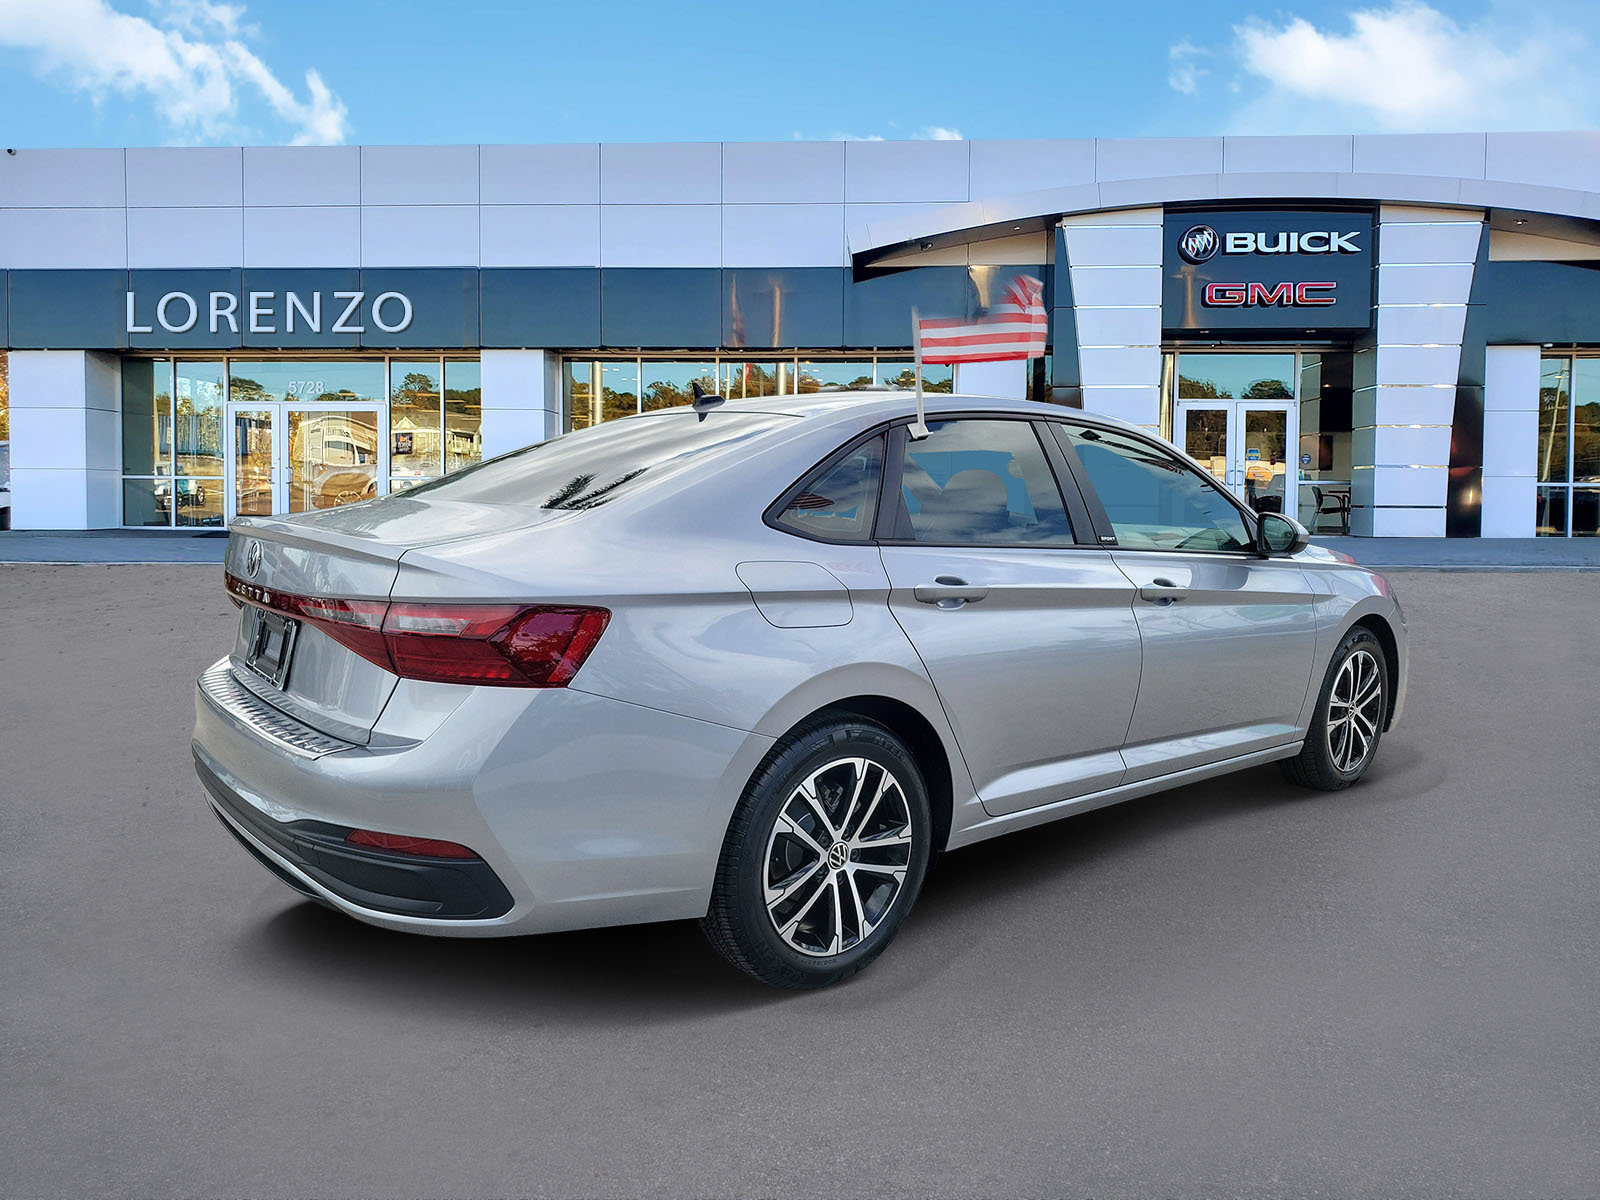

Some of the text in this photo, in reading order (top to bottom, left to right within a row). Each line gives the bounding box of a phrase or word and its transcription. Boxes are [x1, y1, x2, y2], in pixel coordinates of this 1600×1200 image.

[1225, 231, 1362, 253] BUICK
[1204, 281, 1337, 306] GMC
[126, 291, 413, 334] LORENZO
[288, 380, 325, 394] 5728
